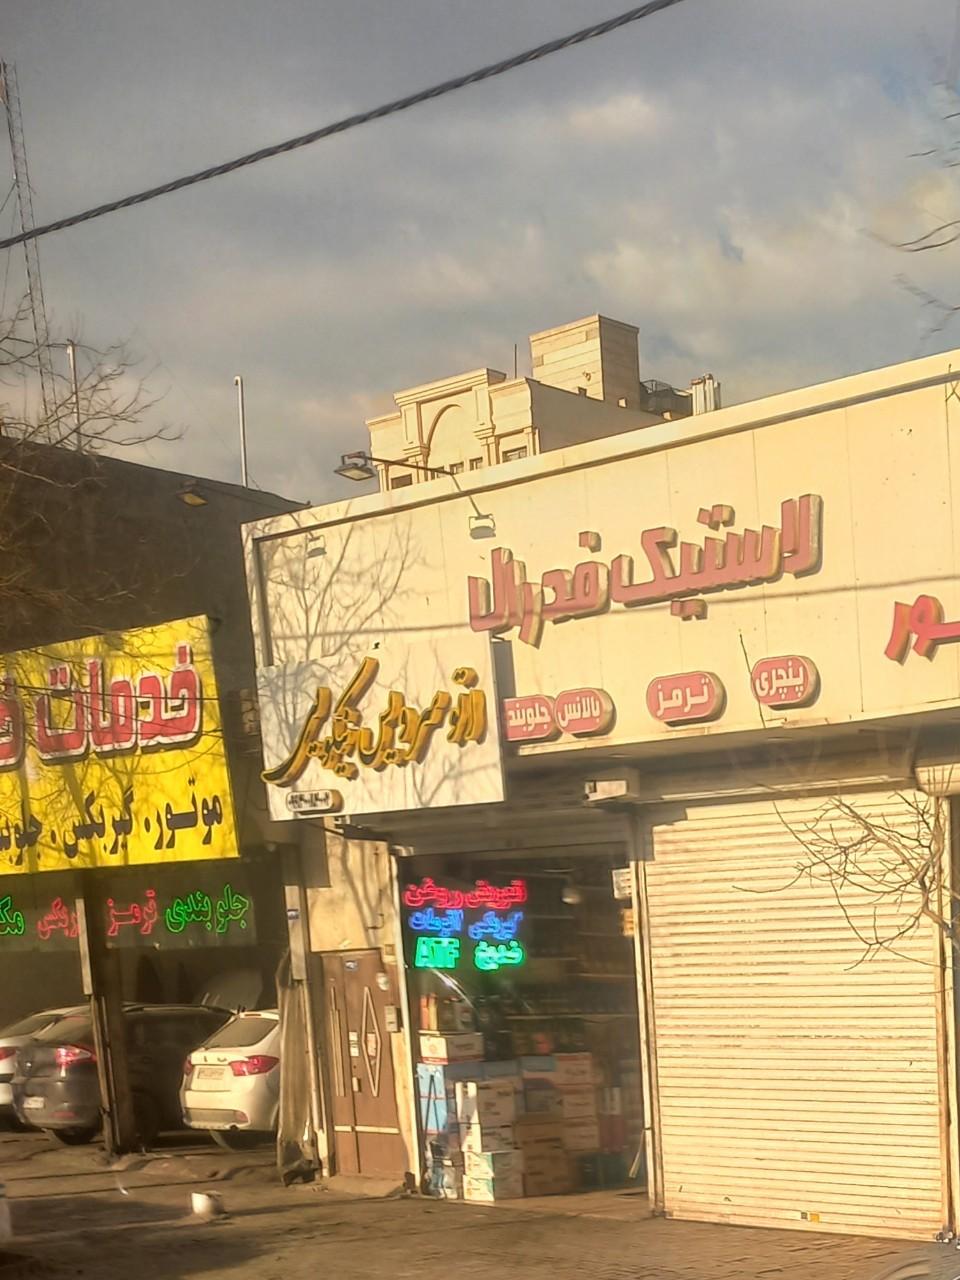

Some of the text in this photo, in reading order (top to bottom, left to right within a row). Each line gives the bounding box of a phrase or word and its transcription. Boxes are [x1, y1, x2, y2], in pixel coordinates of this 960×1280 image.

[467, 493, 824, 648] لاستیک فدرال
[655, 677, 710, 717] ترمز
[755, 660, 806, 700] پنچری
[36, 641, 202, 765] خدمات
[507, 703, 552, 732] جلوبند
[557, 693, 601, 729] بالانس
[63, 789, 134, 859] گیربکس
[154, 777, 223, 850] موتور
[415, 937, 460, 968] ATF
